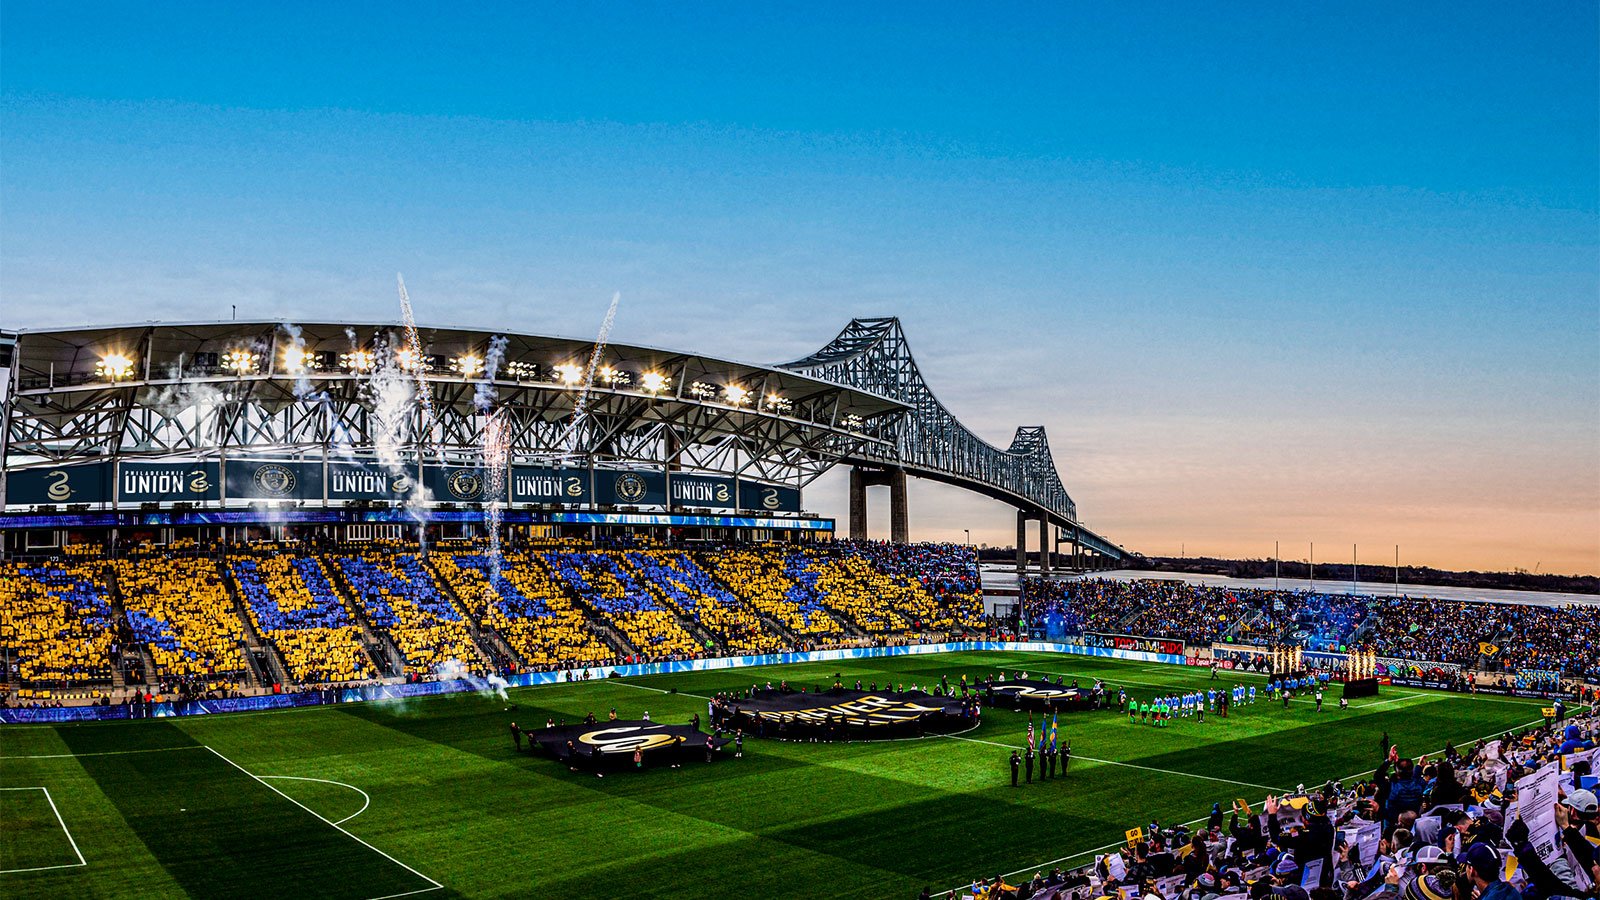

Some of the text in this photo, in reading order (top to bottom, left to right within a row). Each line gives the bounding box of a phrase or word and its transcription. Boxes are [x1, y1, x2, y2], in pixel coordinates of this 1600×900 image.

[125, 475, 184, 493] UNION
[333, 475, 387, 493] UNION
[516, 479, 563, 497] UNION
[673, 484, 713, 501] UNION
